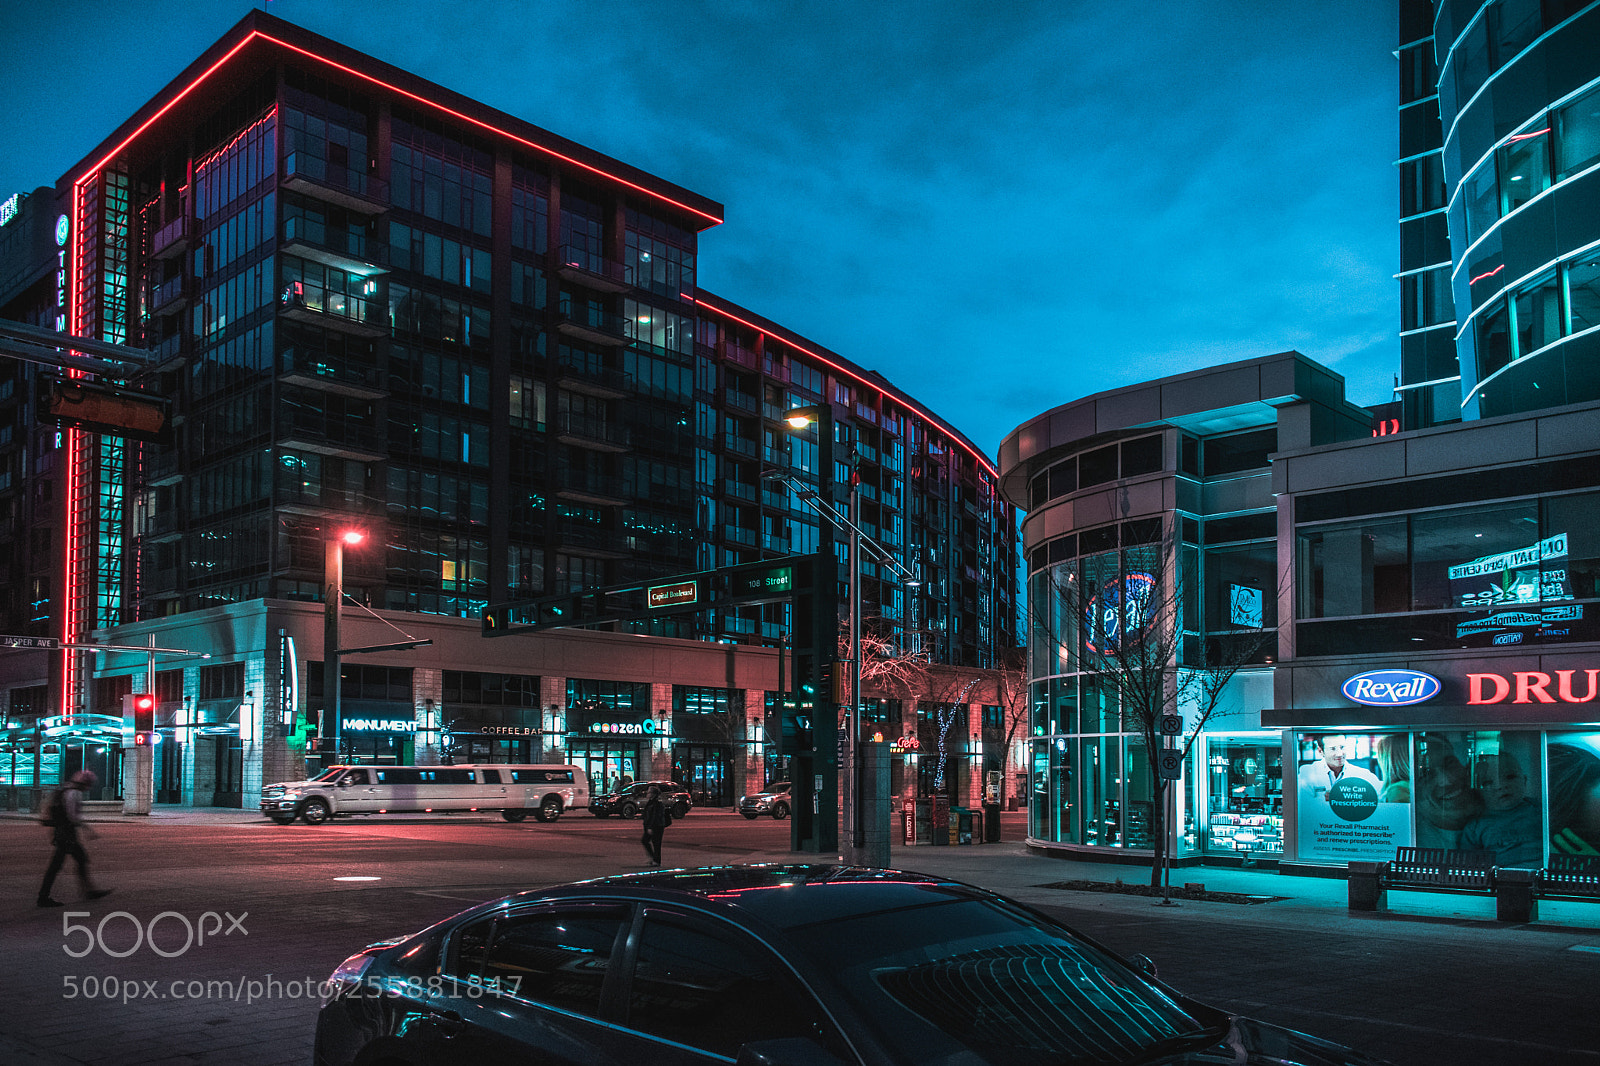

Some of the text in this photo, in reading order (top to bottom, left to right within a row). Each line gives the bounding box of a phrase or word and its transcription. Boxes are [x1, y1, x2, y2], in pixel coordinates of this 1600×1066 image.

[748, 575, 788, 588] 108 Street
[652, 591, 669, 602] Capital
[4, 637, 52, 647] JASPER AVE
[1354, 677, 1427, 702] Rexall
[342, 718, 420, 732] MONUMENT
[481, 726, 544, 736] COFFEE BAR
